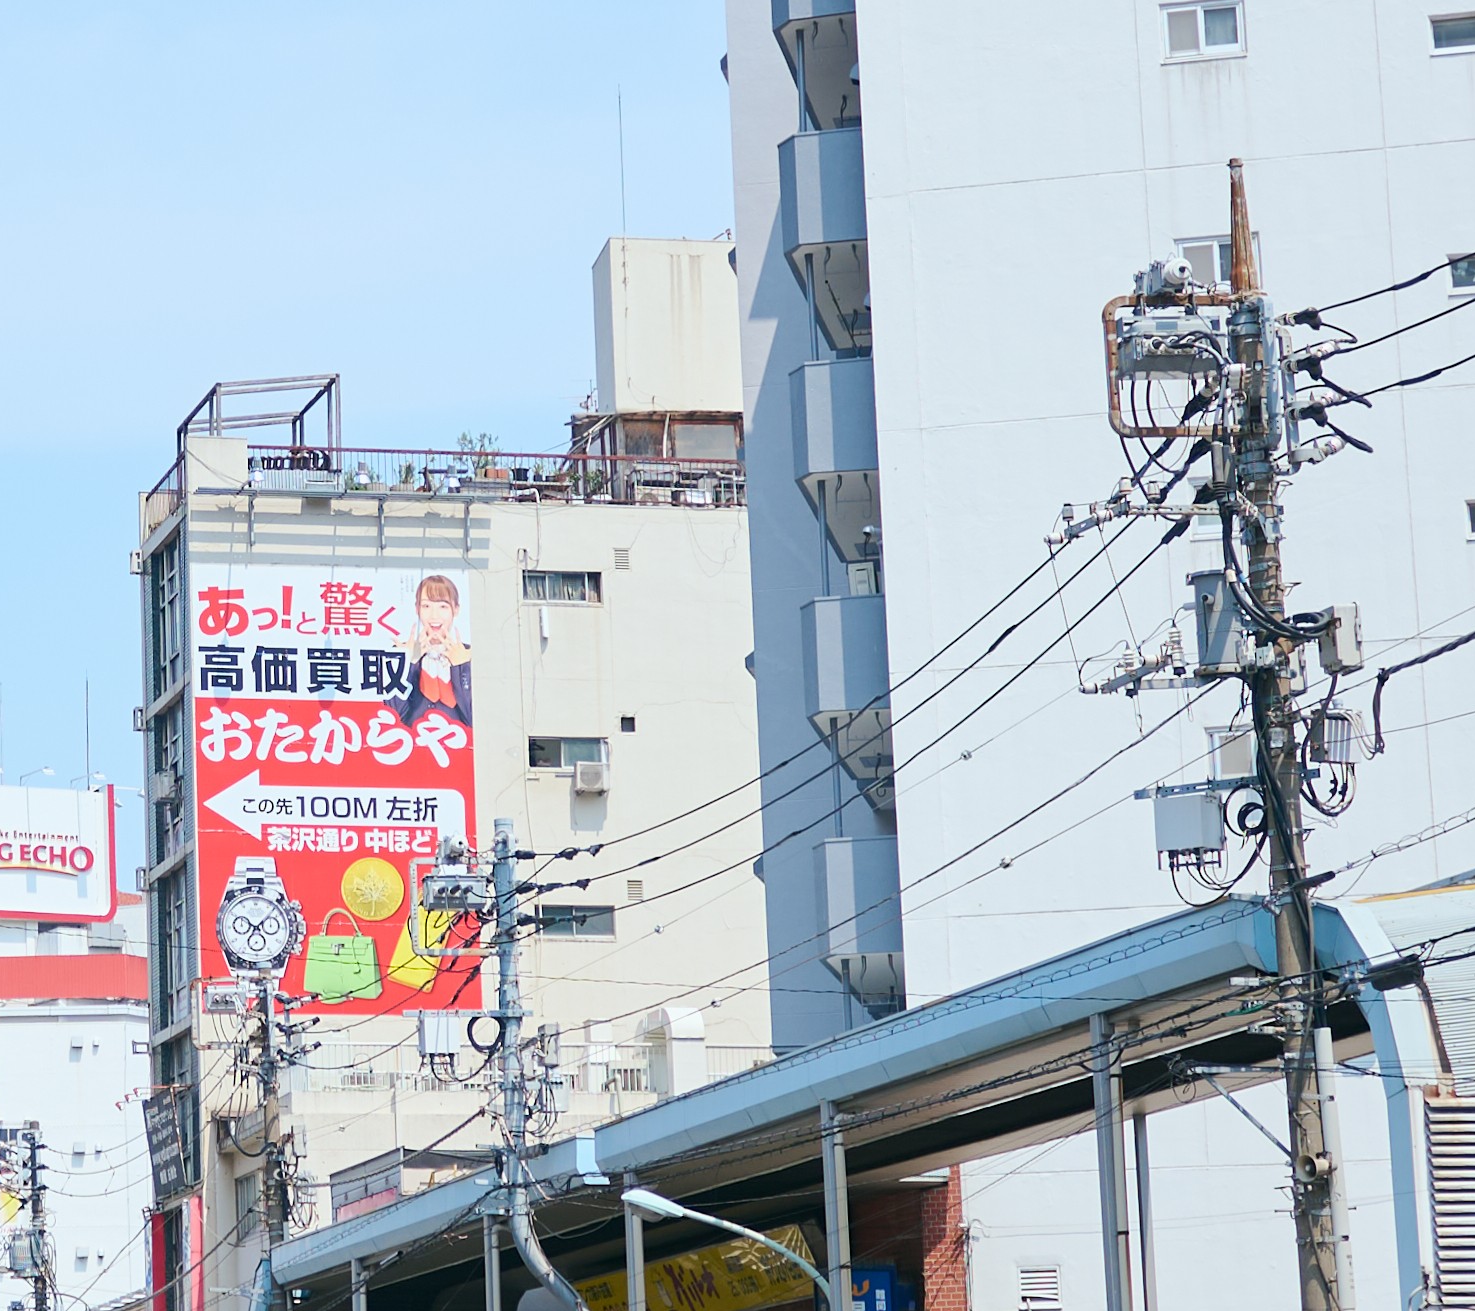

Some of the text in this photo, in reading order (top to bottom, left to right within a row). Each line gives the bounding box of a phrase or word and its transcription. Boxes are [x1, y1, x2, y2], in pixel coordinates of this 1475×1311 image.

[198, 644, 409, 695] 高価買取
[199, 706, 468, 769] おたからや
[386, 796, 439, 823] 左折
[267, 825, 434, 854] 茶沢通り 中ほど
[19, 844, 95, 872] ECHO
